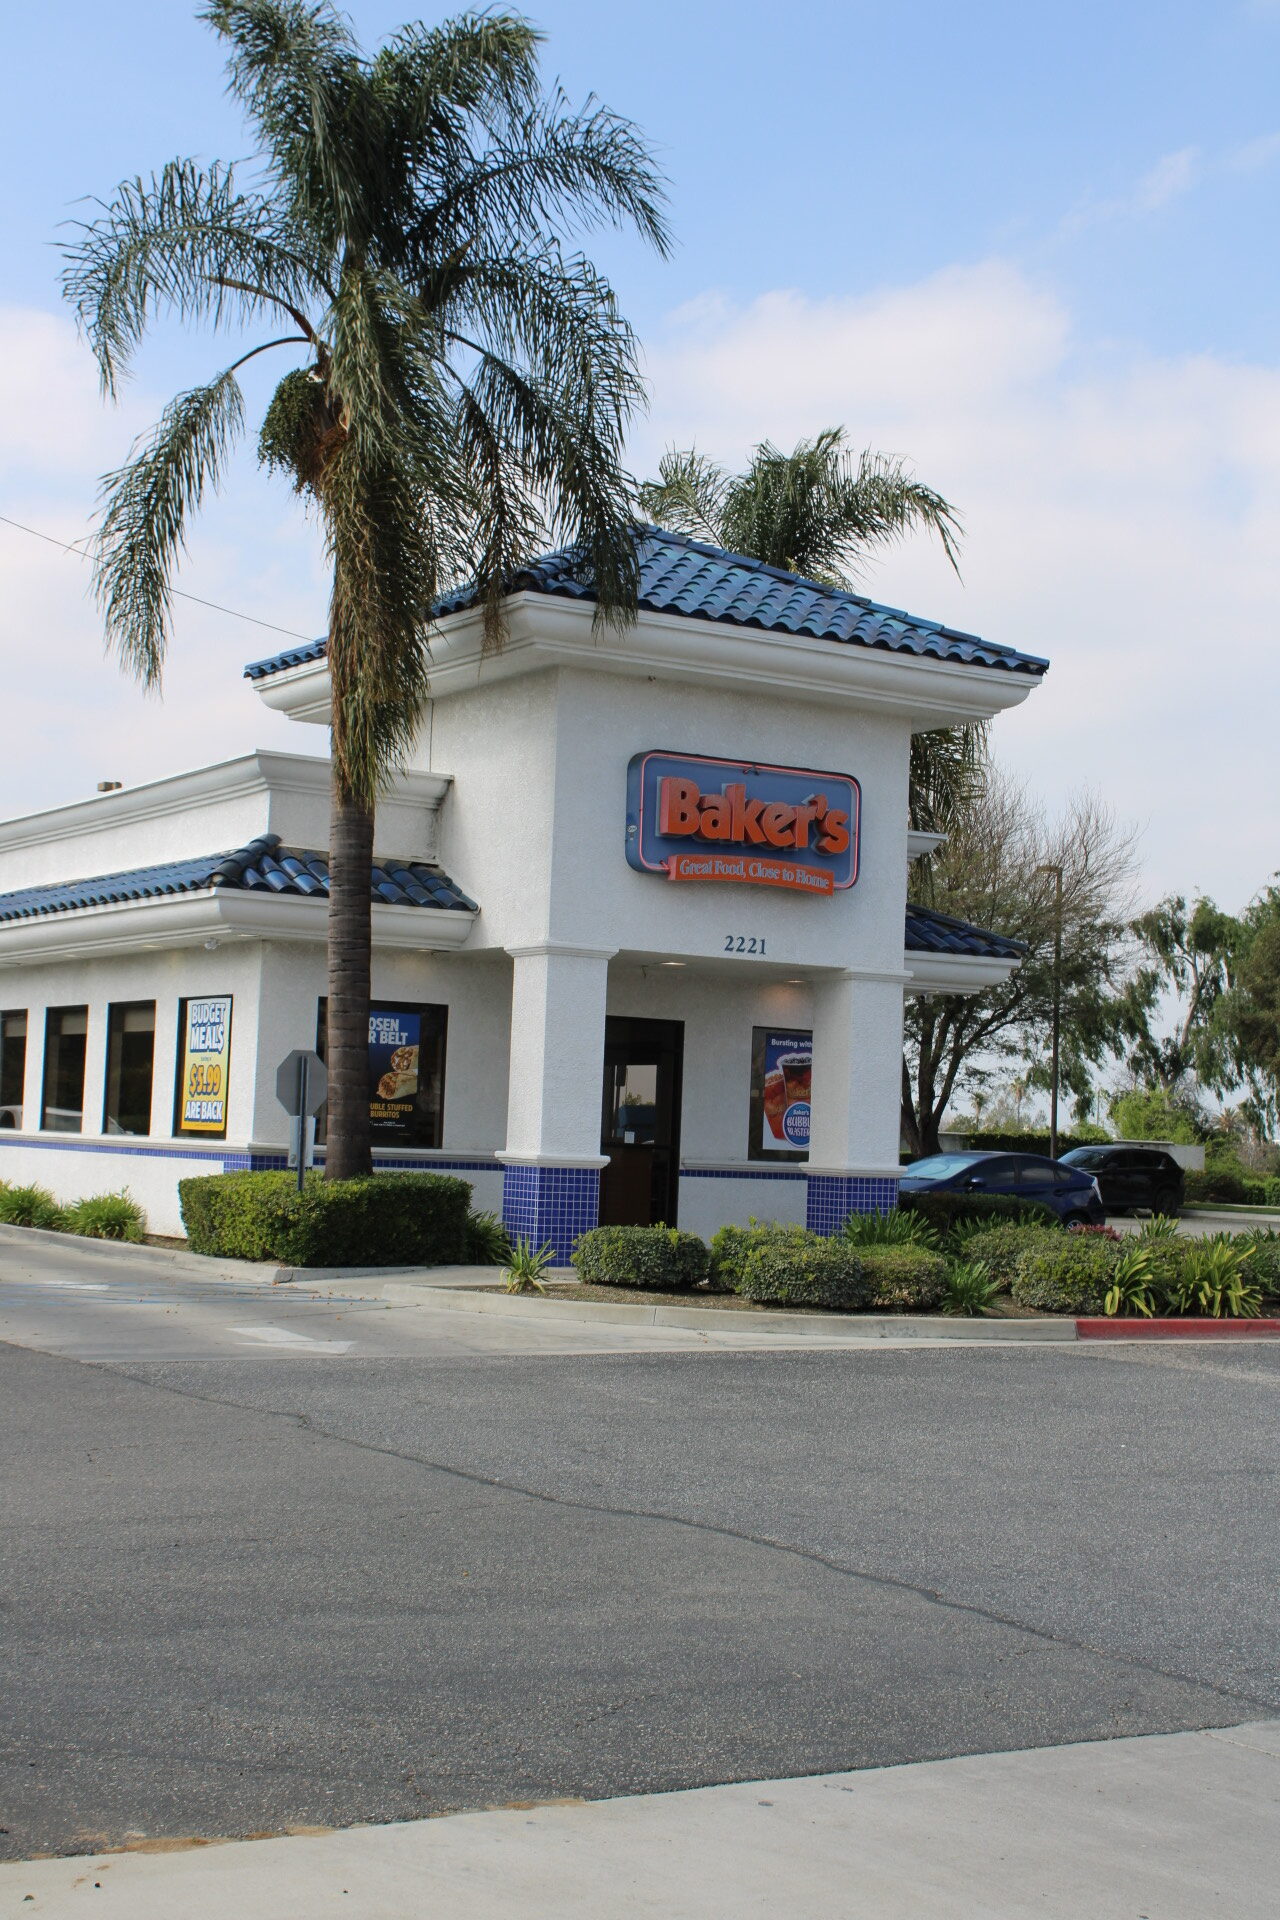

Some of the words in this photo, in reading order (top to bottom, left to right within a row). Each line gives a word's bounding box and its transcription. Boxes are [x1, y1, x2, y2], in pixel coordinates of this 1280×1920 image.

[657, 776, 849, 855] Baker's
[679, 859, 712, 875] Great
[715, 860, 746, 878] Food,
[749, 862, 780, 879] Close
[783, 868, 795, 882] to
[796, 869, 830, 890] Home
[724, 935, 766, 955] 2221
[191, 1003, 226, 1026] BUDGET
[368, 1016, 400, 1032] OSEN
[379, 1031, 409, 1046] BELT
[771, 1038, 798, 1049] Bursting
[189, 1063, 221, 1097] $5.99
[184, 1100, 201, 1122] ARE
[201, 1100, 224, 1123] BACK
[369, 1102, 386, 1111] UBLE
[387, 1103, 414, 1112] STUFFED
[370, 1110, 400, 1119] BURRITOS
[786, 1116, 810, 1128] BUBBL
